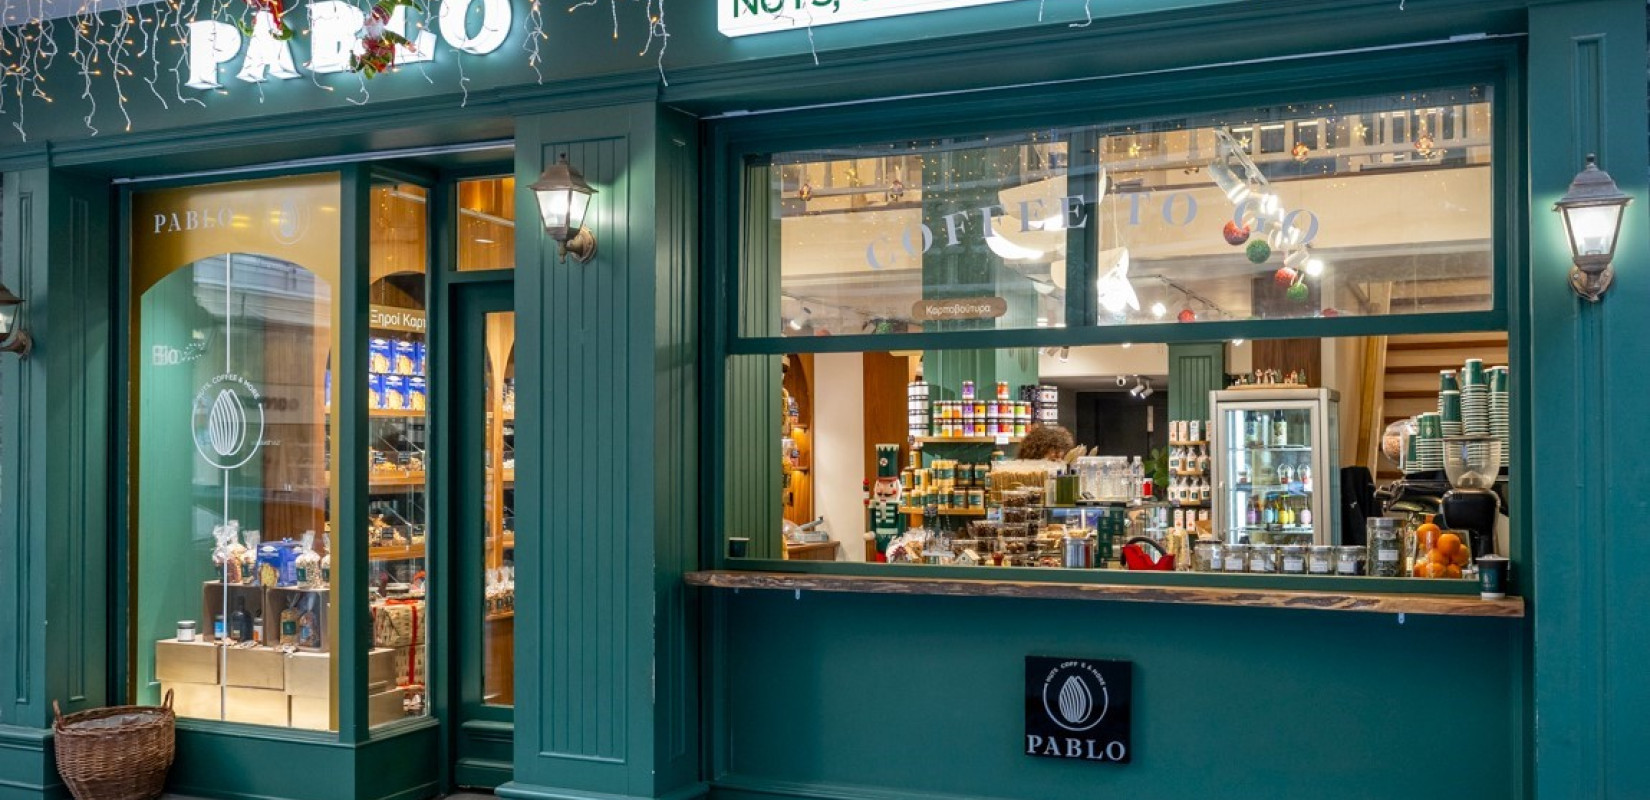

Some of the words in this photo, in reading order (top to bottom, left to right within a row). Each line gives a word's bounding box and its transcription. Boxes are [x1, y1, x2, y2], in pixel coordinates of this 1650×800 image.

[185, 0, 513, 89] PABLO
[154, 207, 234, 233] PABLO
[866, 194, 1088, 269] COFFEE
[1120, 192, 1198, 226] TO
[1234, 199, 1319, 244] GO
[370, 309, 400, 327] Ξηροί
[212, 374, 238, 384] COFFEE
[243, 380, 260, 399] MORE
[1092, 668, 1106, 686] MORE
[1027, 734, 1126, 761] PABLO
